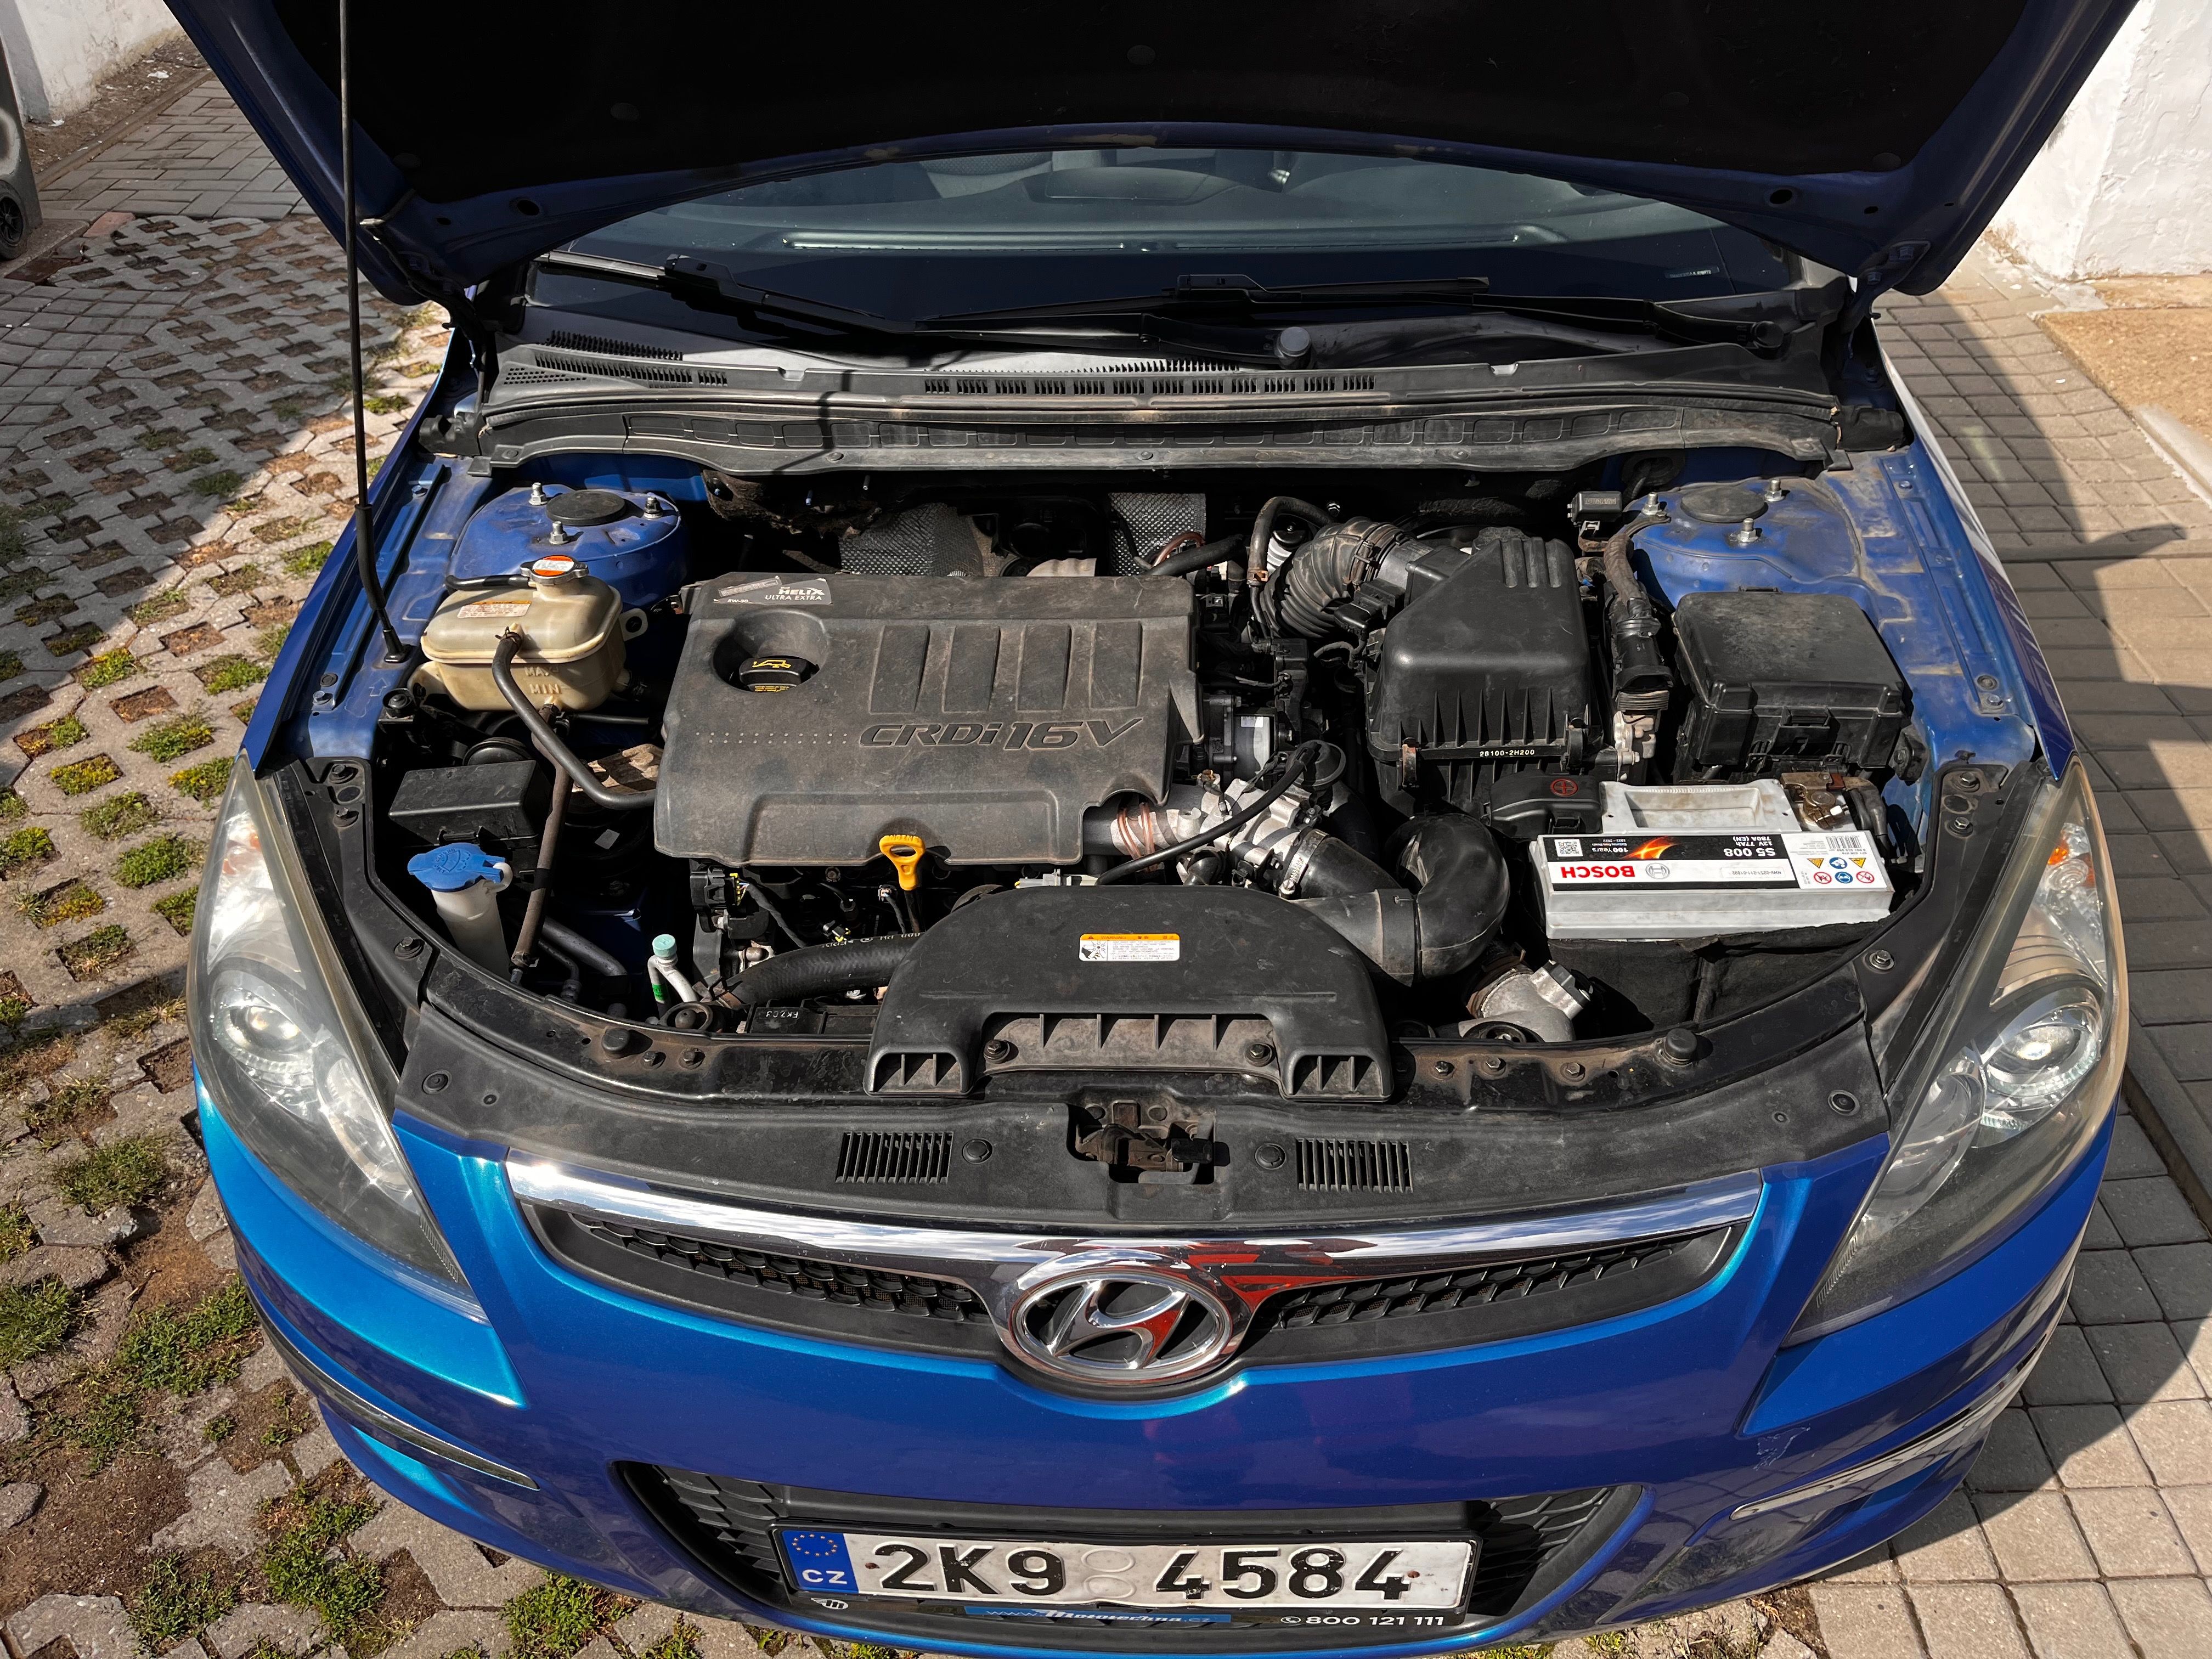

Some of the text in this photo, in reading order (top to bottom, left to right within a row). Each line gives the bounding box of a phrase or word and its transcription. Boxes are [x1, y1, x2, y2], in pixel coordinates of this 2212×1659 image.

[778, 586, 825, 595] HELIX
[530, 684, 562, 695] MIN
[1723, 848, 1776, 857] S5 008
[1560, 866, 1635, 878] BOSCH
[802, 1568, 848, 1584] CZ
[874, 1543, 1412, 1600] 2K9 4584
[1306, 1616, 1444, 1626] 800 121 111
